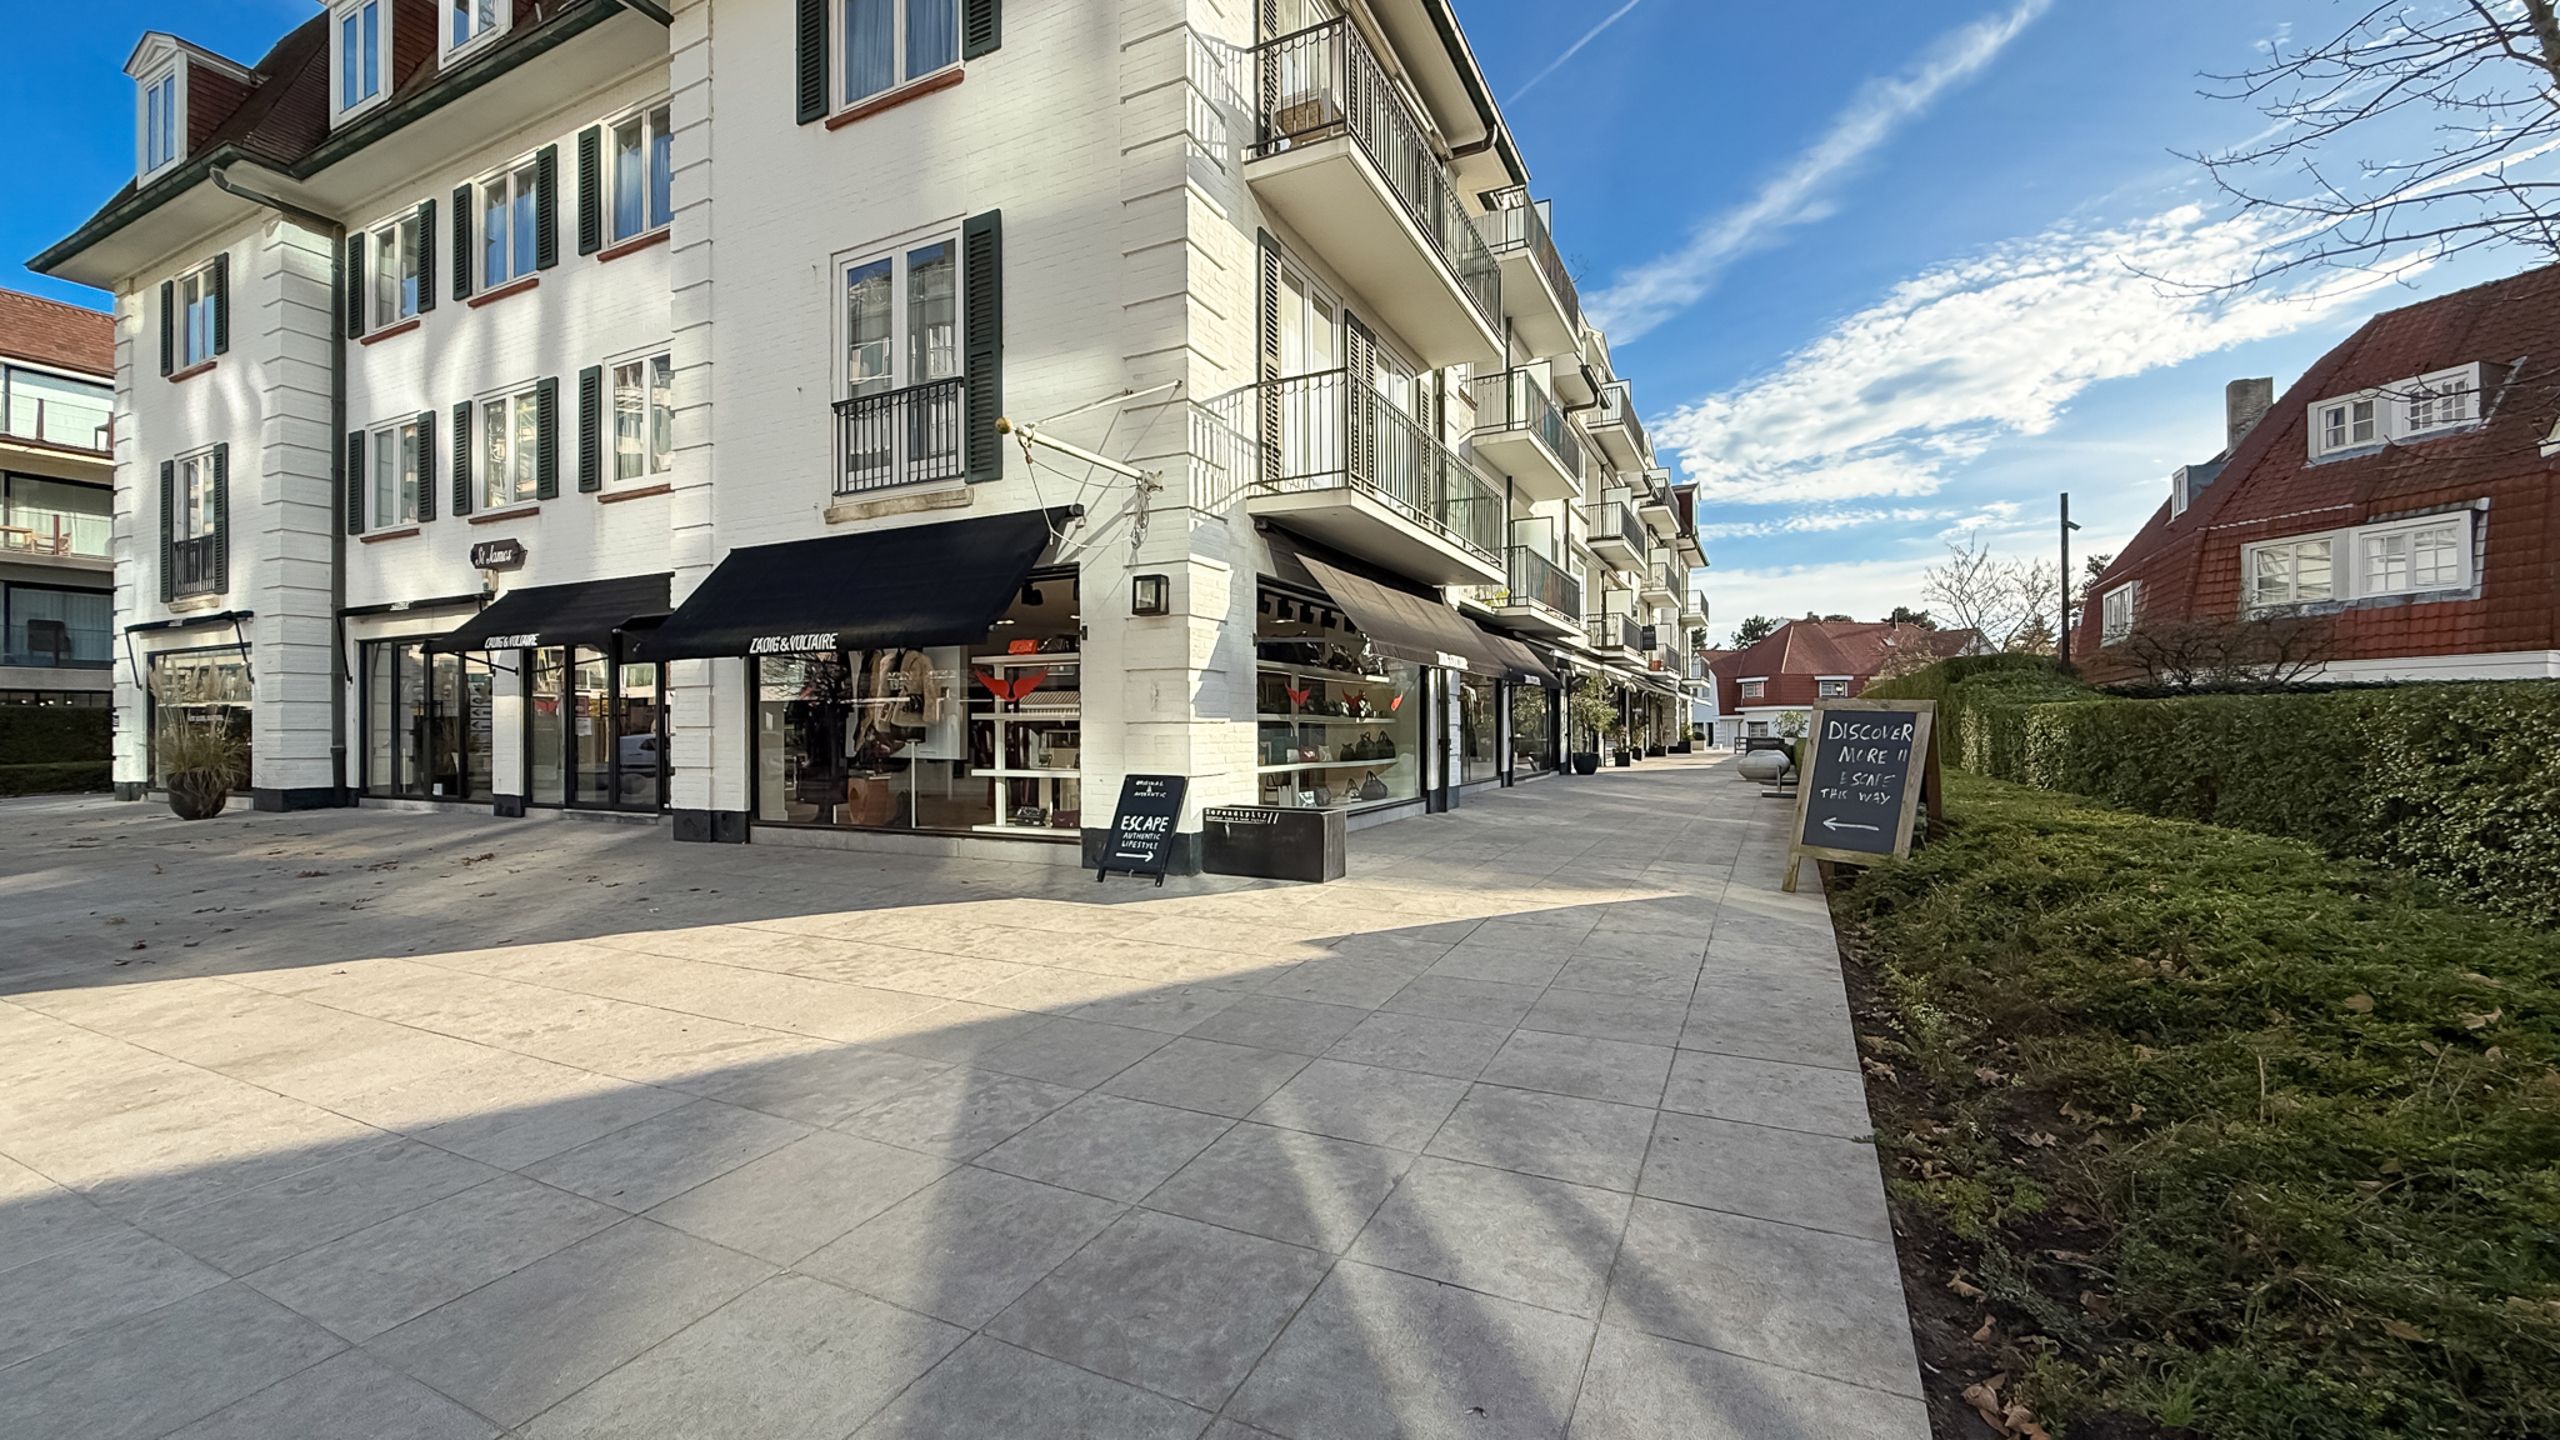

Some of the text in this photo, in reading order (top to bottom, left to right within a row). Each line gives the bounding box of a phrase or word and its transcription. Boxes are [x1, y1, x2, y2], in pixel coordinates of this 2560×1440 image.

[1828, 720, 1913, 742] DISCOVER
[1838, 746, 1888, 765] MORE
[1820, 788, 1891, 805] THIS WAY
[1121, 815, 1169, 832] ESCAPE
[1122, 832, 1161, 840] AUTHENTIC
